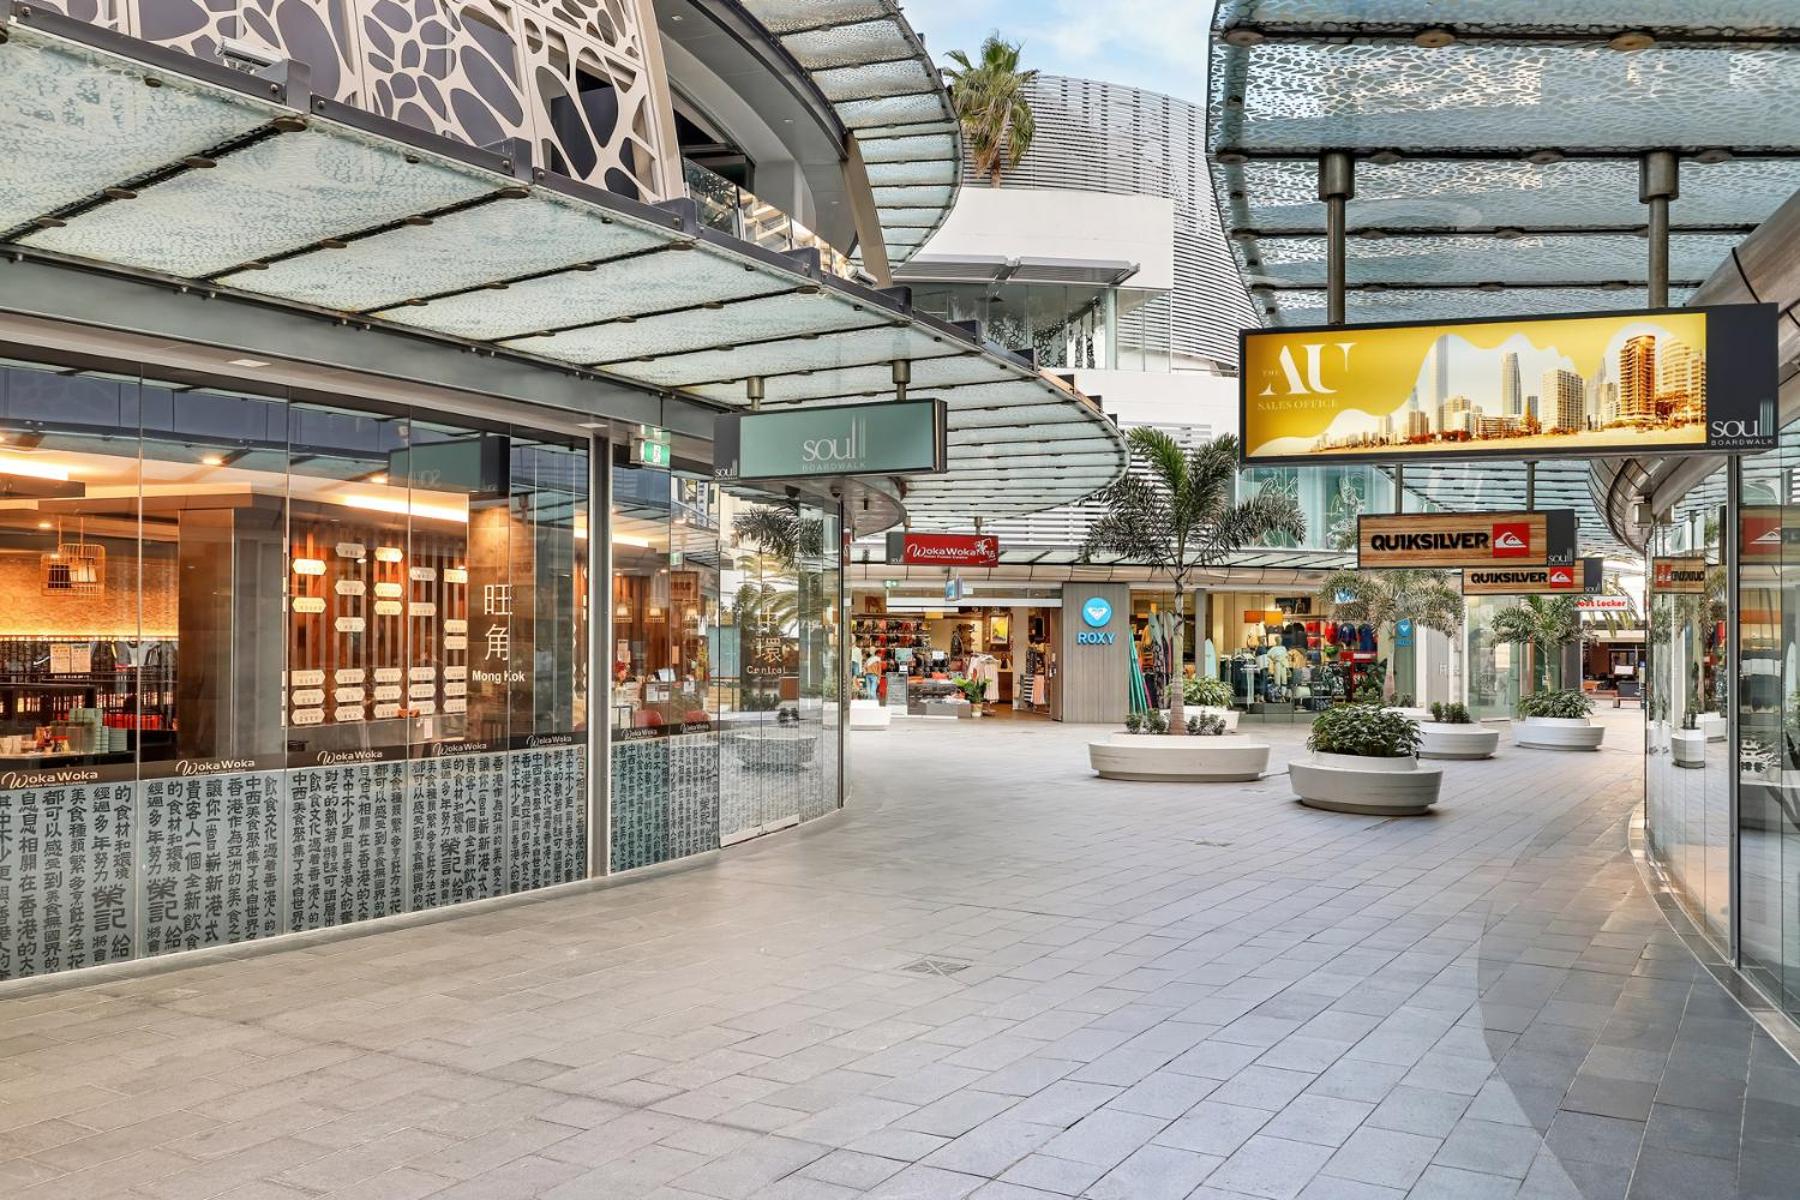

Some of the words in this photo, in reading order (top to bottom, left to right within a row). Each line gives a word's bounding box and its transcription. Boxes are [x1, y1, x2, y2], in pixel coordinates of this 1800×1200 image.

[1257, 400, 1292, 410] SALES
[1294, 399, 1338, 409] OFFICE
[1711, 438, 1774, 446] BOARDWALK
[802, 462, 867, 471] BOARDWALK
[1371, 532, 1490, 551] QUIKSILVER
[1471, 572, 1548, 584] QUIKSILVER
[1597, 599, 1626, 607] Locker
[484, 584, 513, 661] 旺角
[1077, 631, 1116, 646] ROXY
[747, 665, 787, 675] Central
[472, 670, 502, 684] Mong
[504, 670, 525, 682] Kok
